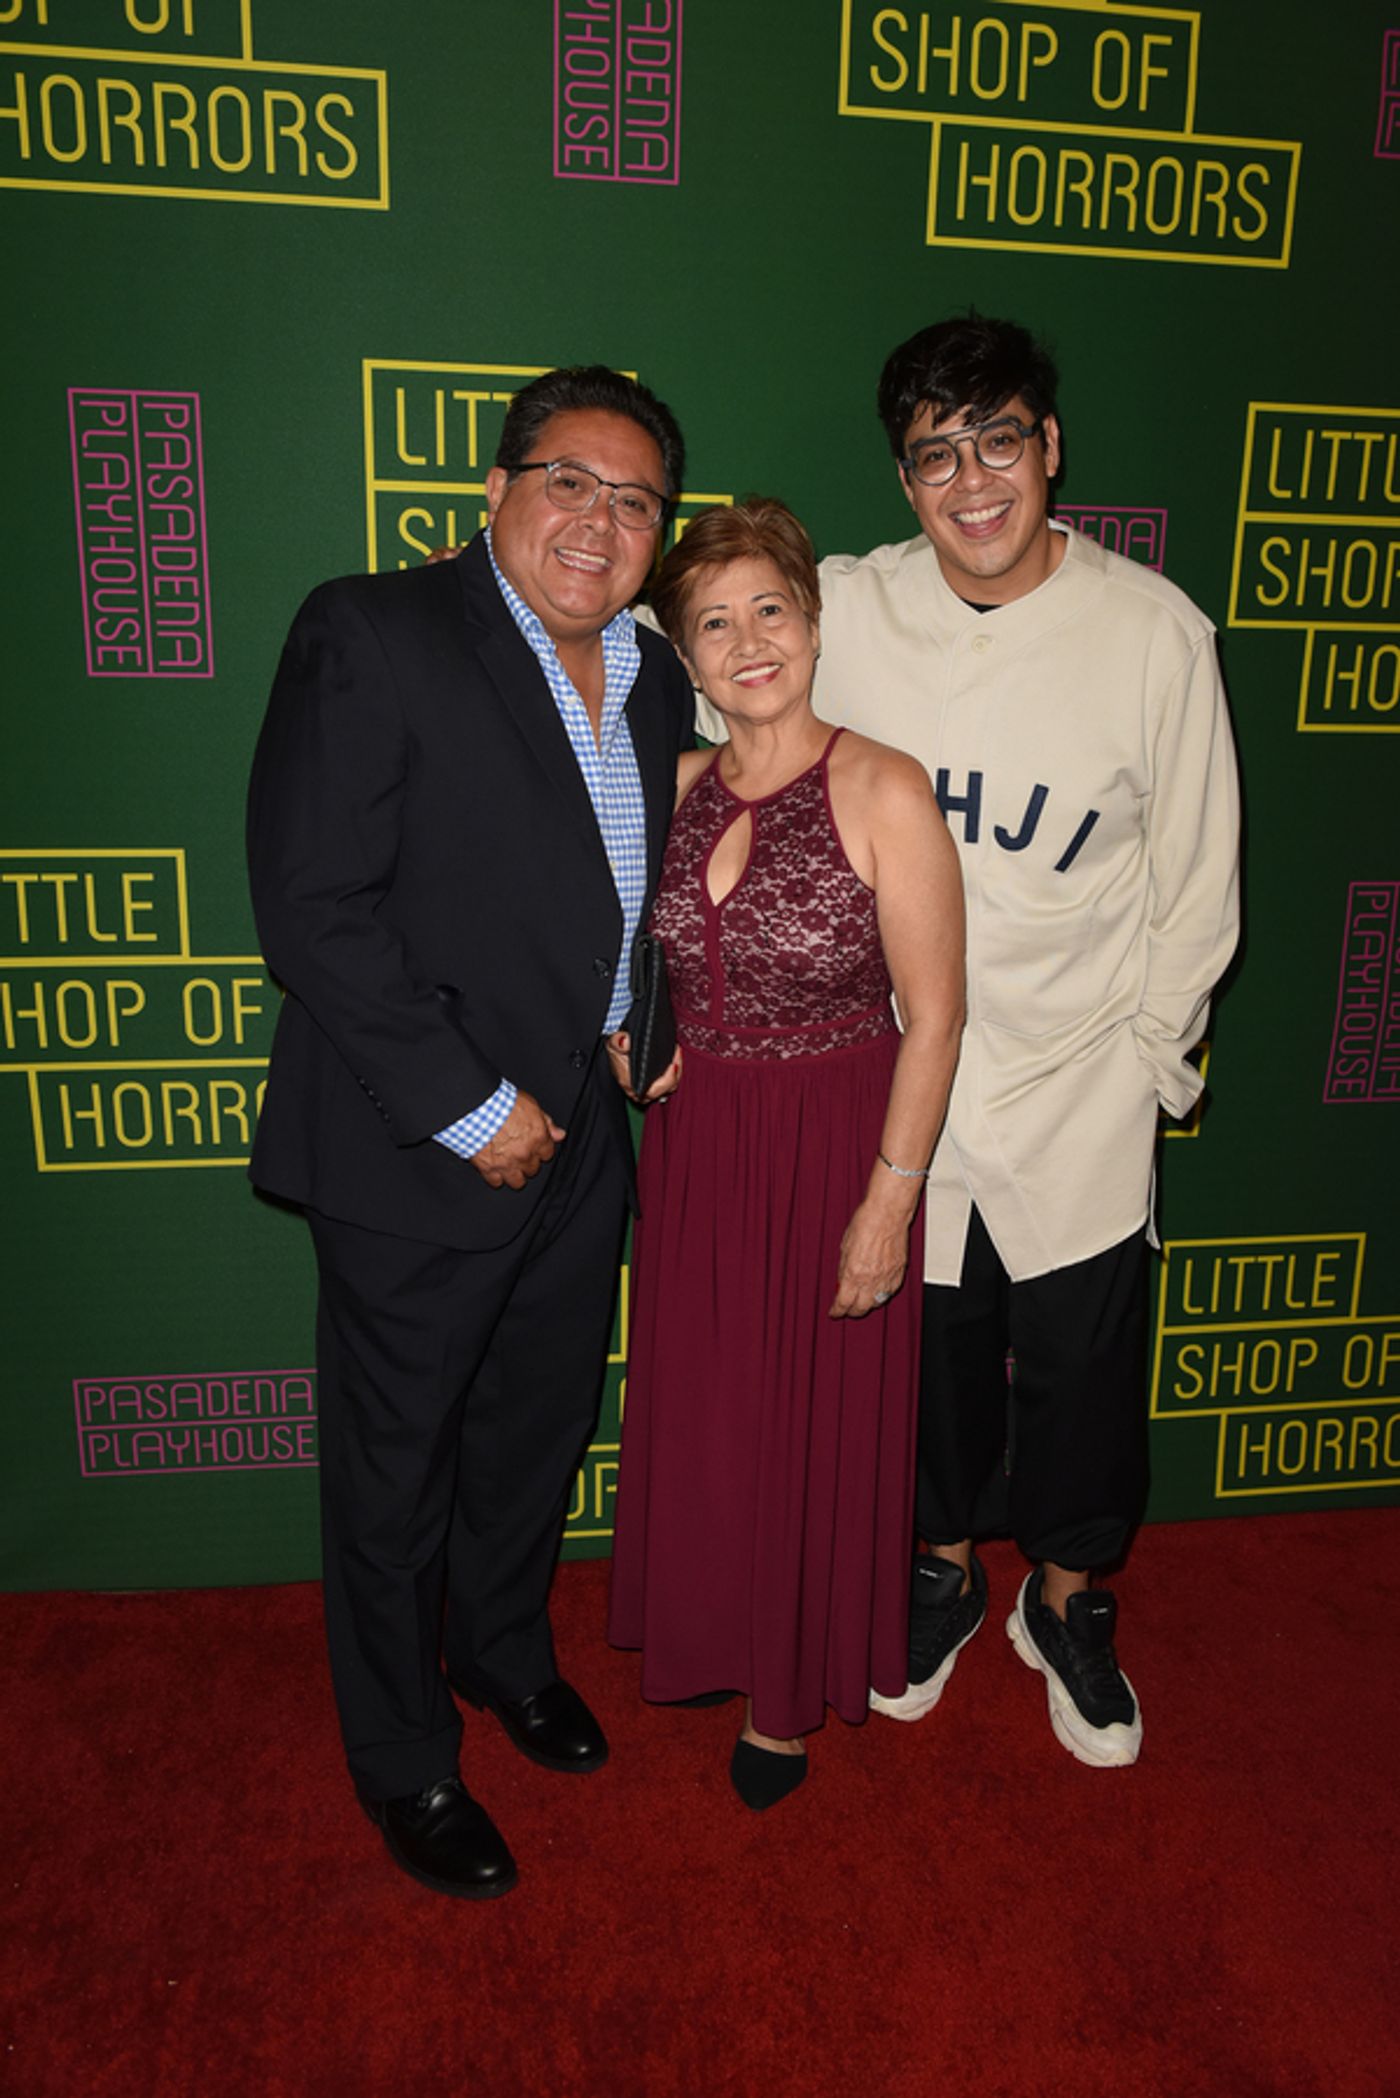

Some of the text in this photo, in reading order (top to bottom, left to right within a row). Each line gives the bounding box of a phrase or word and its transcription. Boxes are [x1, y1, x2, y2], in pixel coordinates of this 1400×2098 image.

[870, 9, 1173, 111] SHOP OF
[956, 142, 1271, 241] HORRORS
[79, 400, 142, 666] PLAYHOUSE
[143, 403, 203, 666] PASADENA
[1324, 644, 1400, 711] HO
[0, 872, 158, 943] TTLE
[0, 977, 263, 1049] HOP OF
[1332, 890, 1391, 1095] PLAYHOUSE
[1183, 1253, 1341, 1314] LITTLE
[83, 1377, 313, 1422] PASADENA
[1174, 1338, 1318, 1399] SHOP
[88, 1424, 316, 1469] PLAYHOUSE
